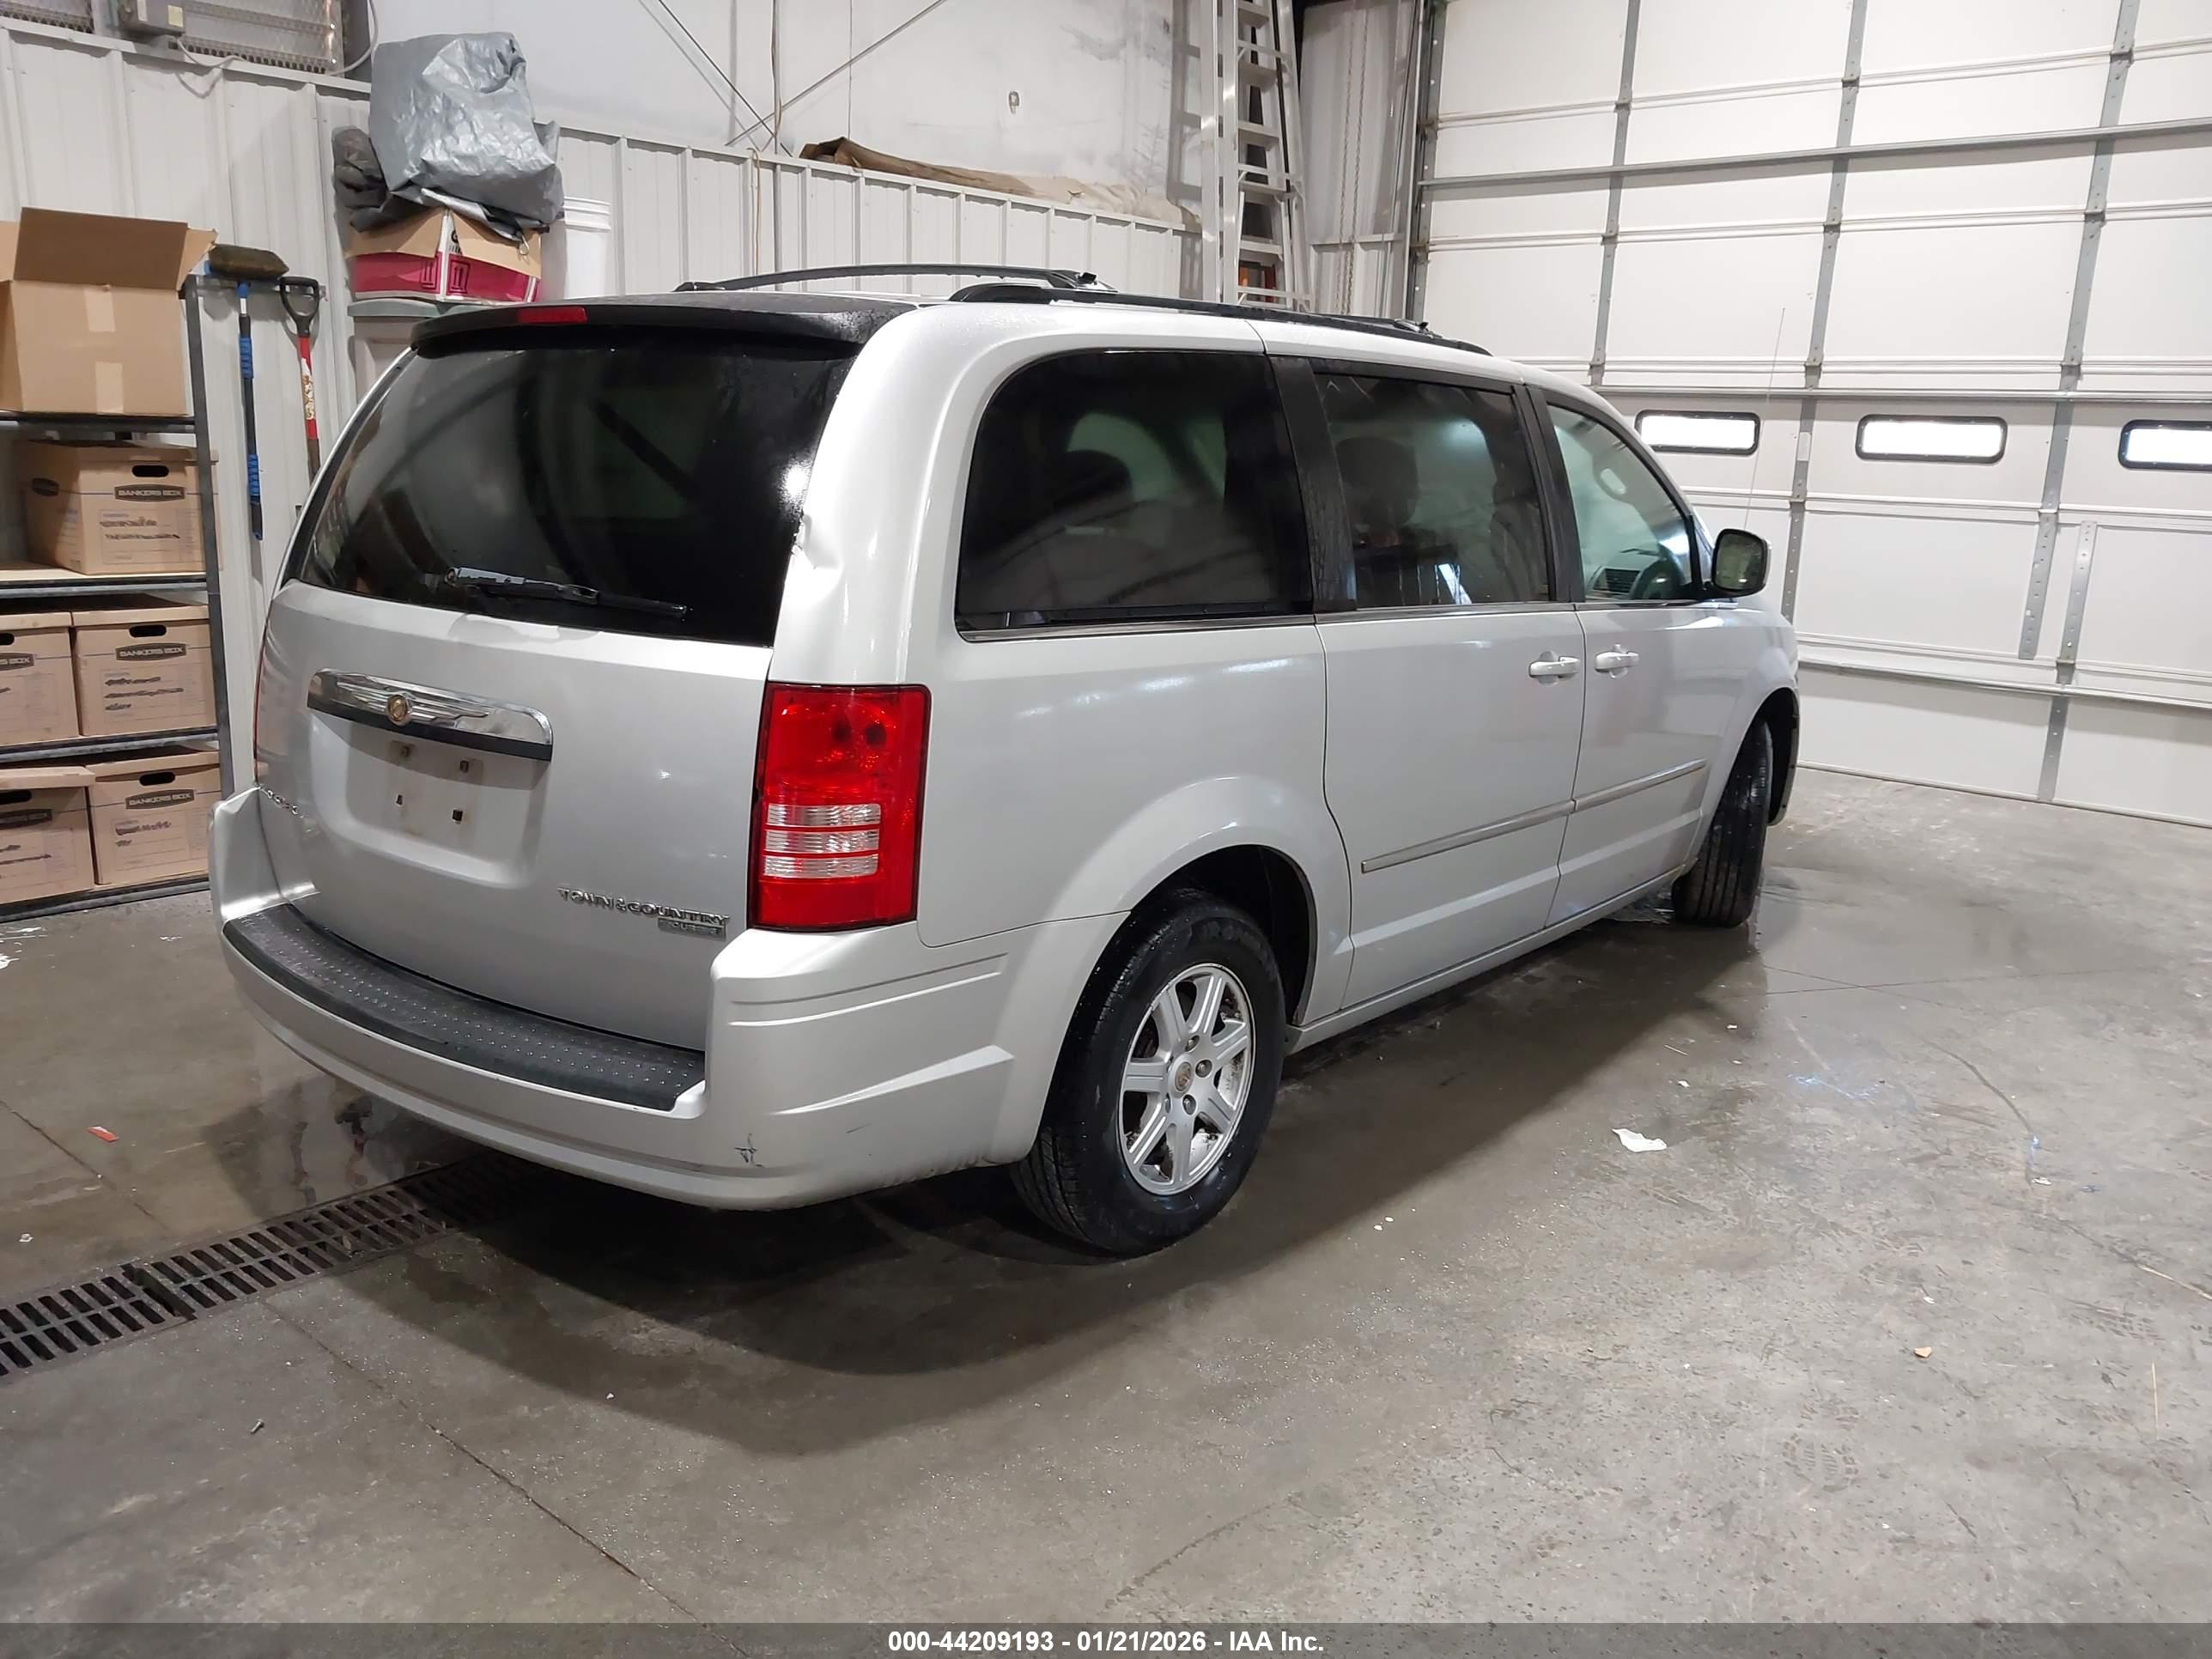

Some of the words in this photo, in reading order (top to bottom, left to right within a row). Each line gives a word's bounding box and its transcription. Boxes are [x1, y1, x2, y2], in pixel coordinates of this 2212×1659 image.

[119, 648, 163, 658] BANKERS
[164, 646, 184, 654] BOX
[129, 795, 171, 805] BANKERS
